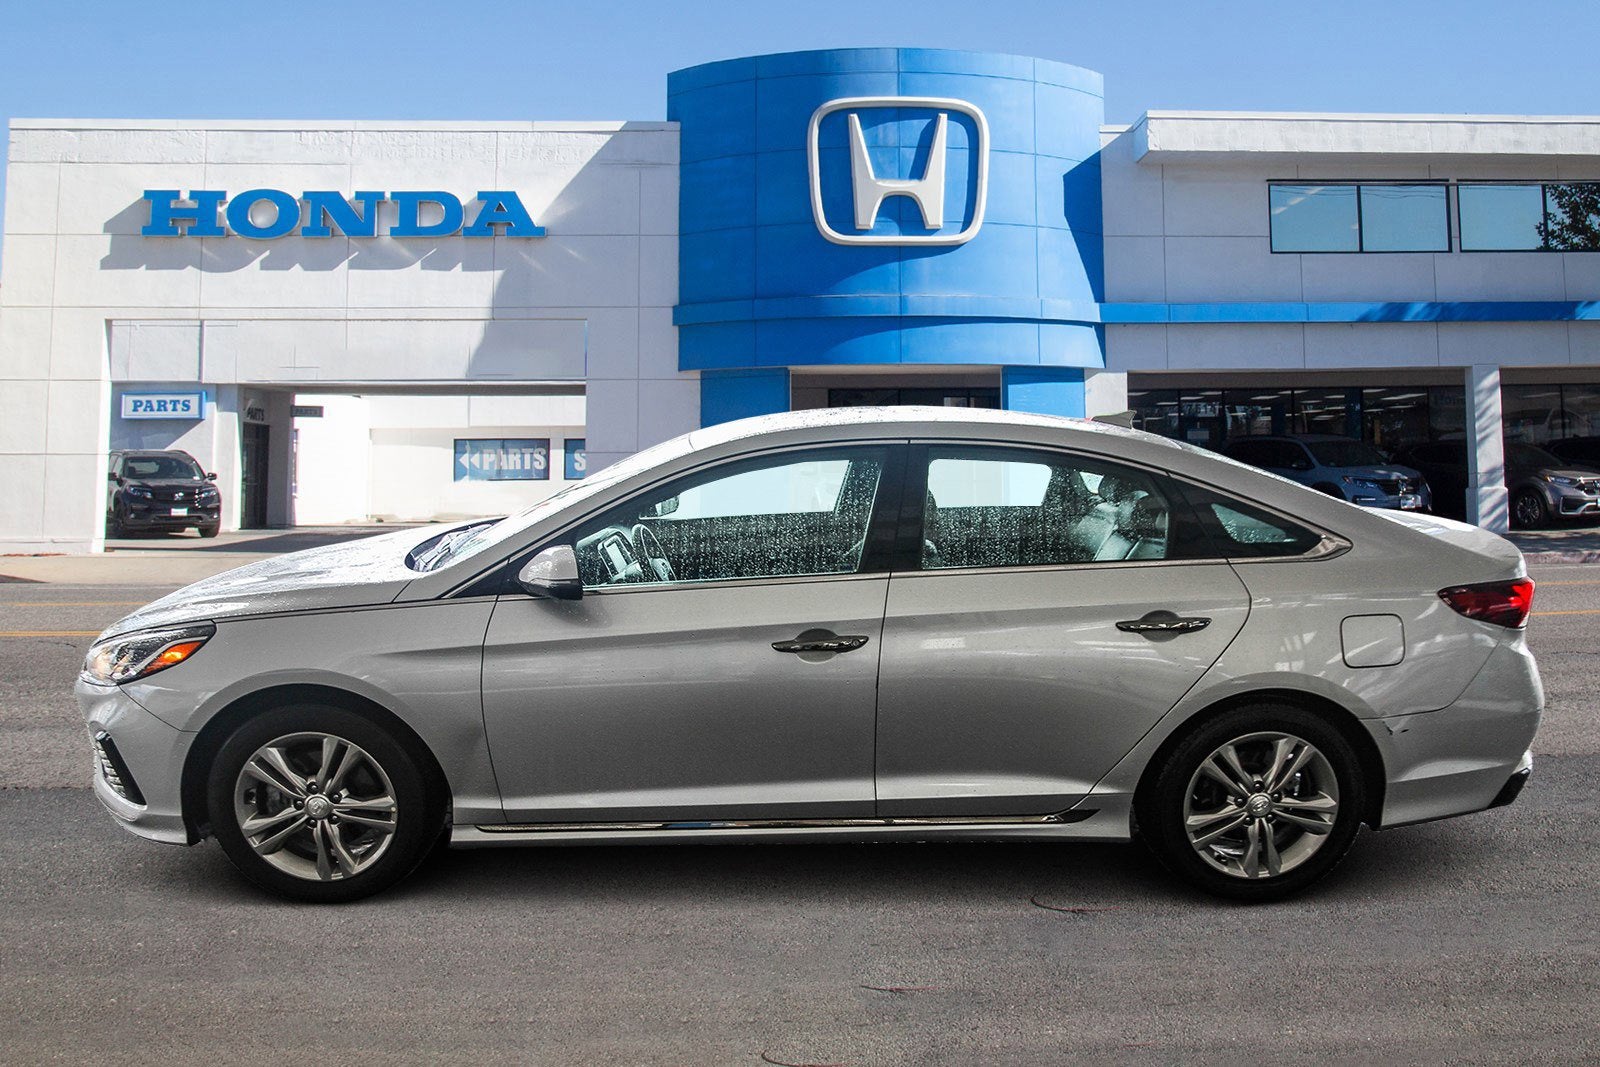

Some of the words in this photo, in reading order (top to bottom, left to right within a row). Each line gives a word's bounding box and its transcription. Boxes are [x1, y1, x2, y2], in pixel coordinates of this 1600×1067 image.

[141, 188, 547, 239] HONDA
[131, 400, 191, 412] PARTS
[482, 448, 547, 470] PARTS
